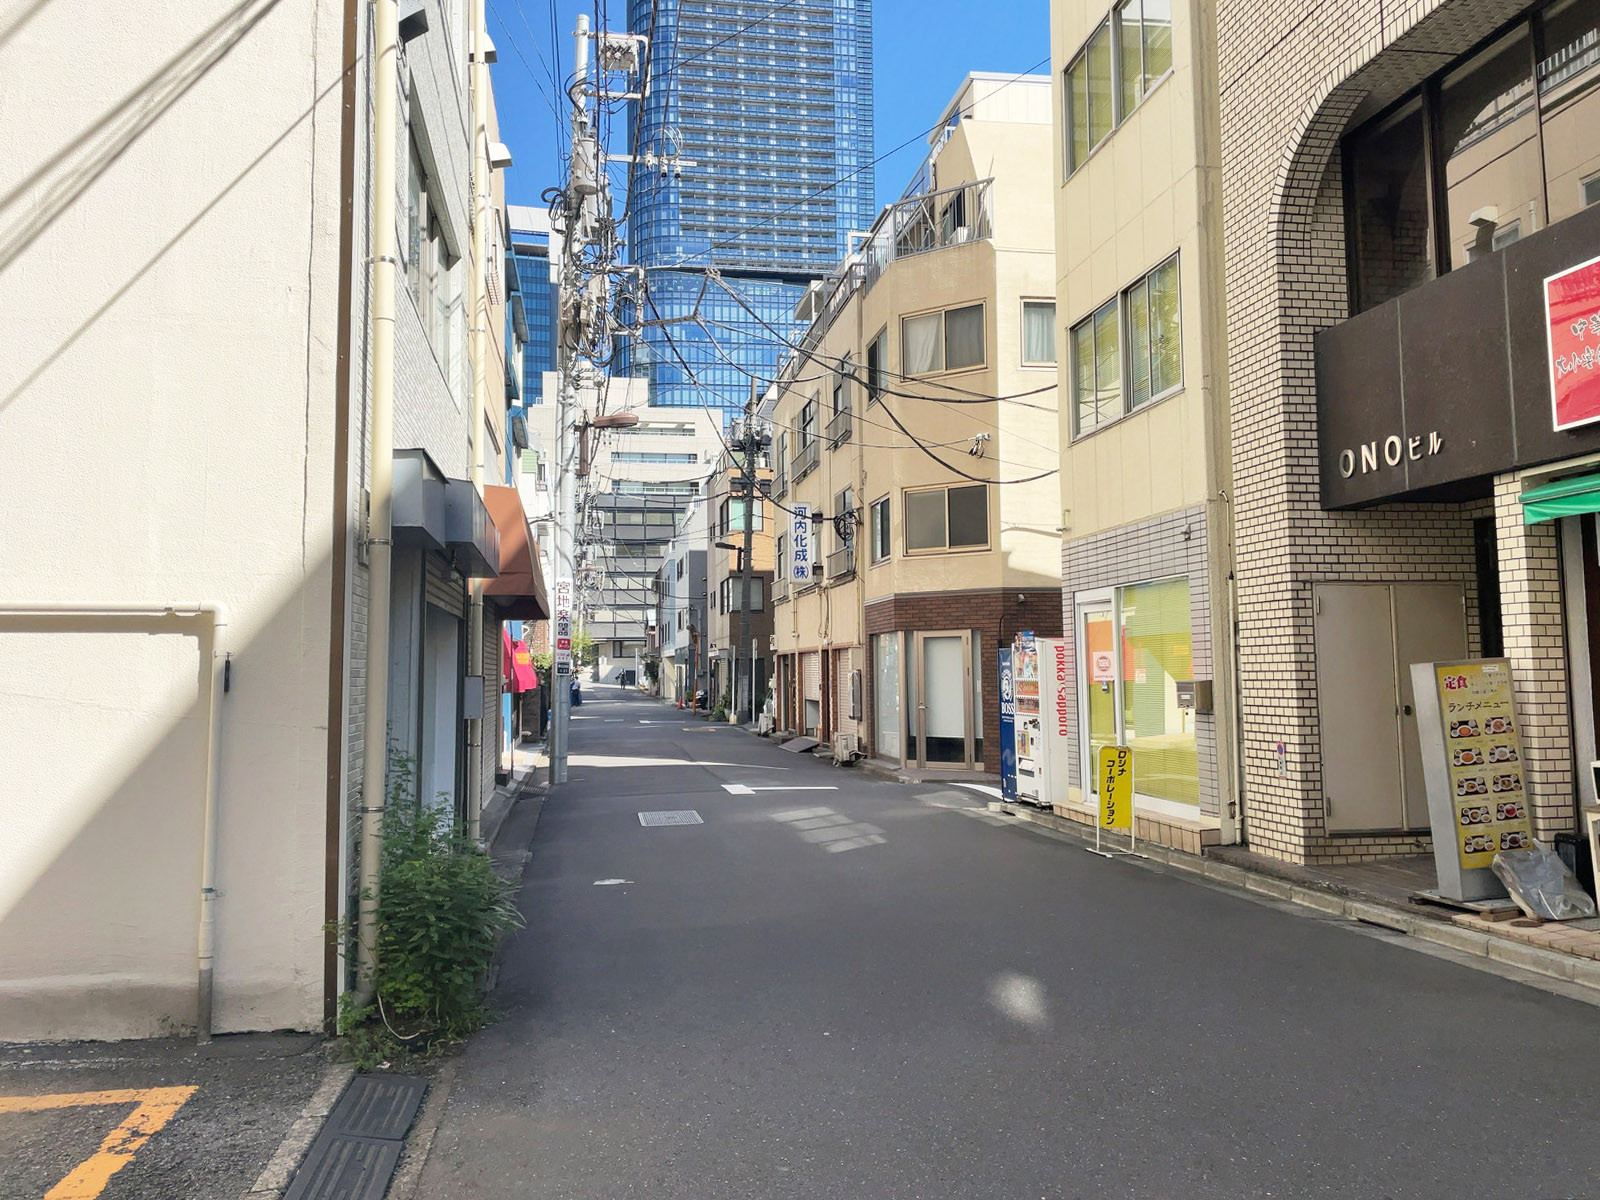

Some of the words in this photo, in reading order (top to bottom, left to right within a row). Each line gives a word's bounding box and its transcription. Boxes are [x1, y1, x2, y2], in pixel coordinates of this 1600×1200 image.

[1556, 344, 1600, 379] 大小宴
[1340, 431, 1443, 478] ONOビル
[556, 581, 571, 636] 宮地楽器
[1444, 675, 1468, 690] 定食
[1001, 702, 1015, 714] BOSS
[1448, 701, 1509, 713] ランチメニュー
[1118, 750, 1127, 776] ロシナ
